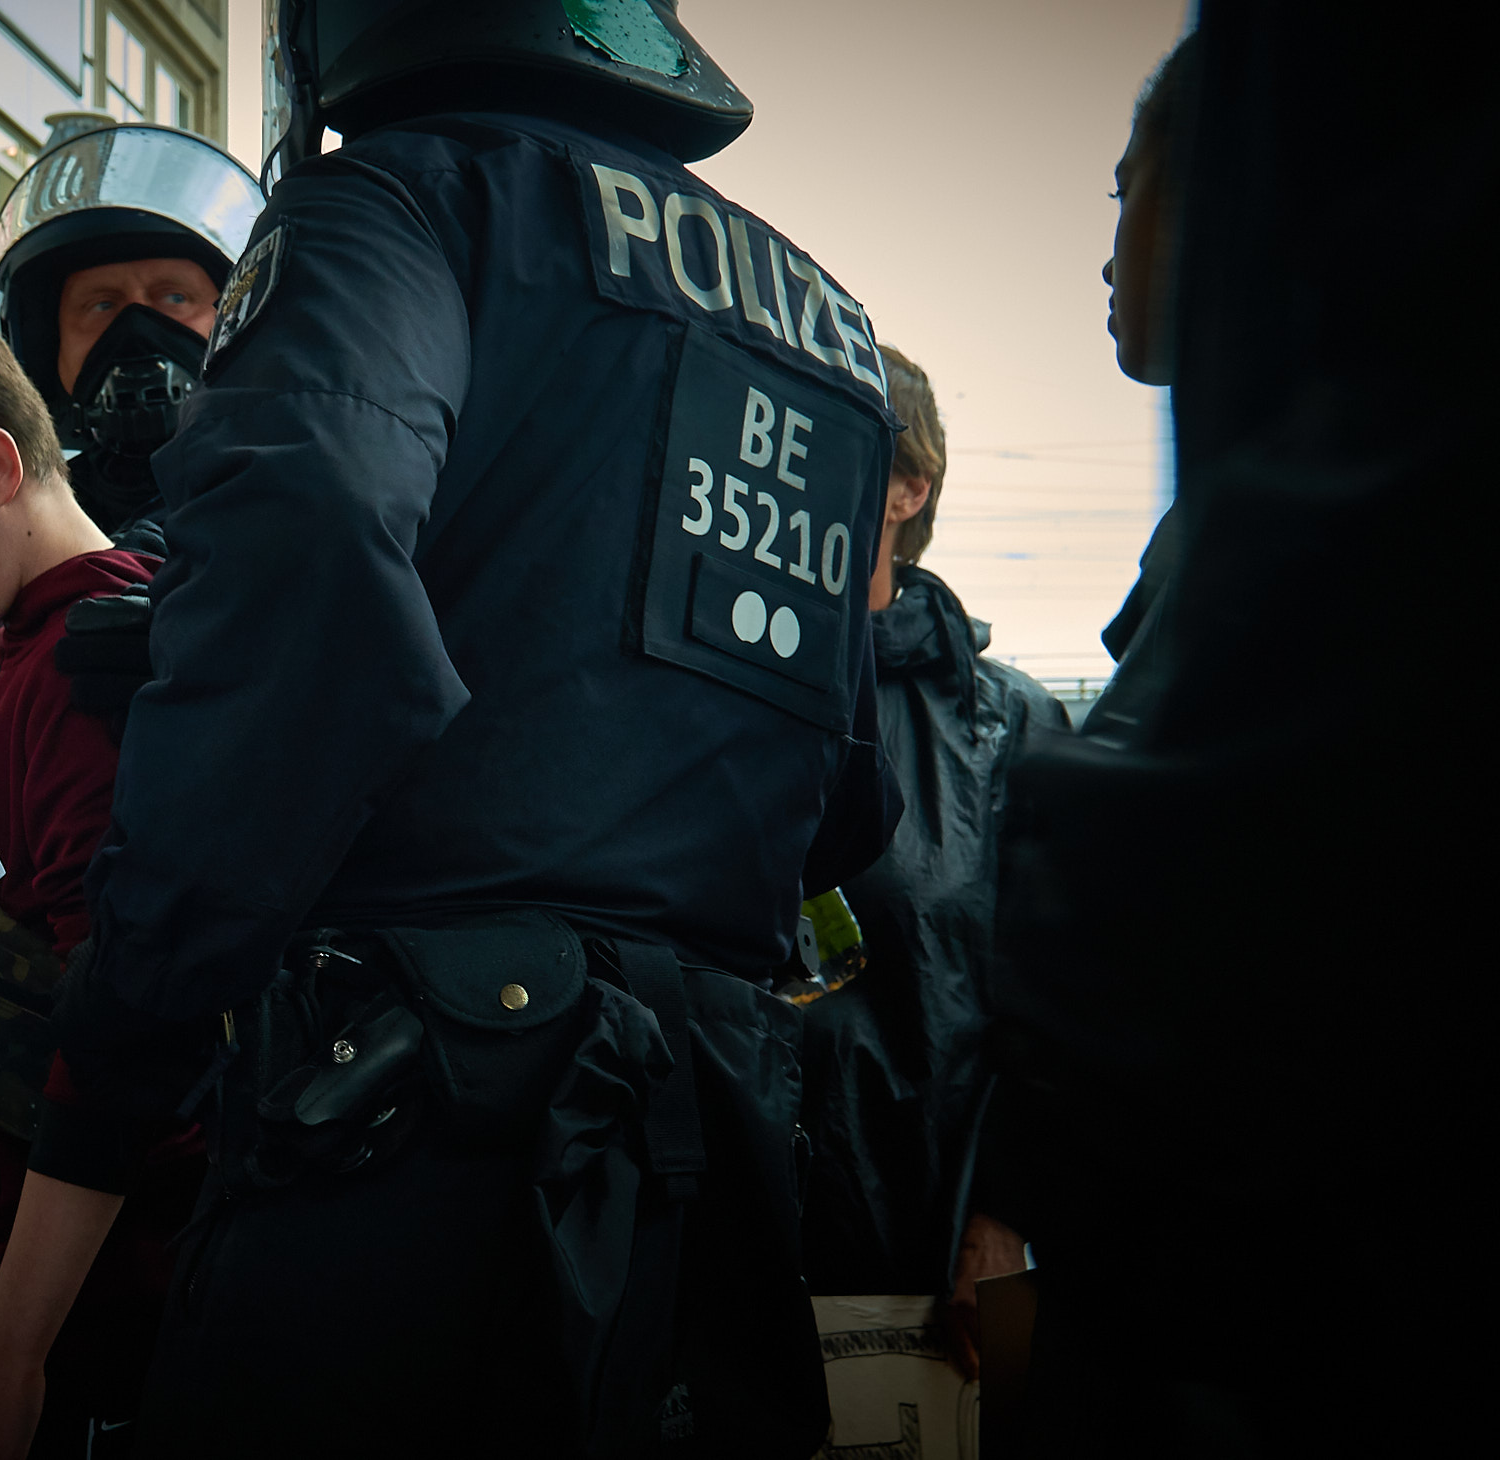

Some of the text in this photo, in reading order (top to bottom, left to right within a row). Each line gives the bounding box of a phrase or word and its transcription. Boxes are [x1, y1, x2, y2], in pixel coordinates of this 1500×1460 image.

[590, 163, 889, 410] POLIZEI
[739, 386, 813, 492] BE
[681, 457, 850, 596] 35210
